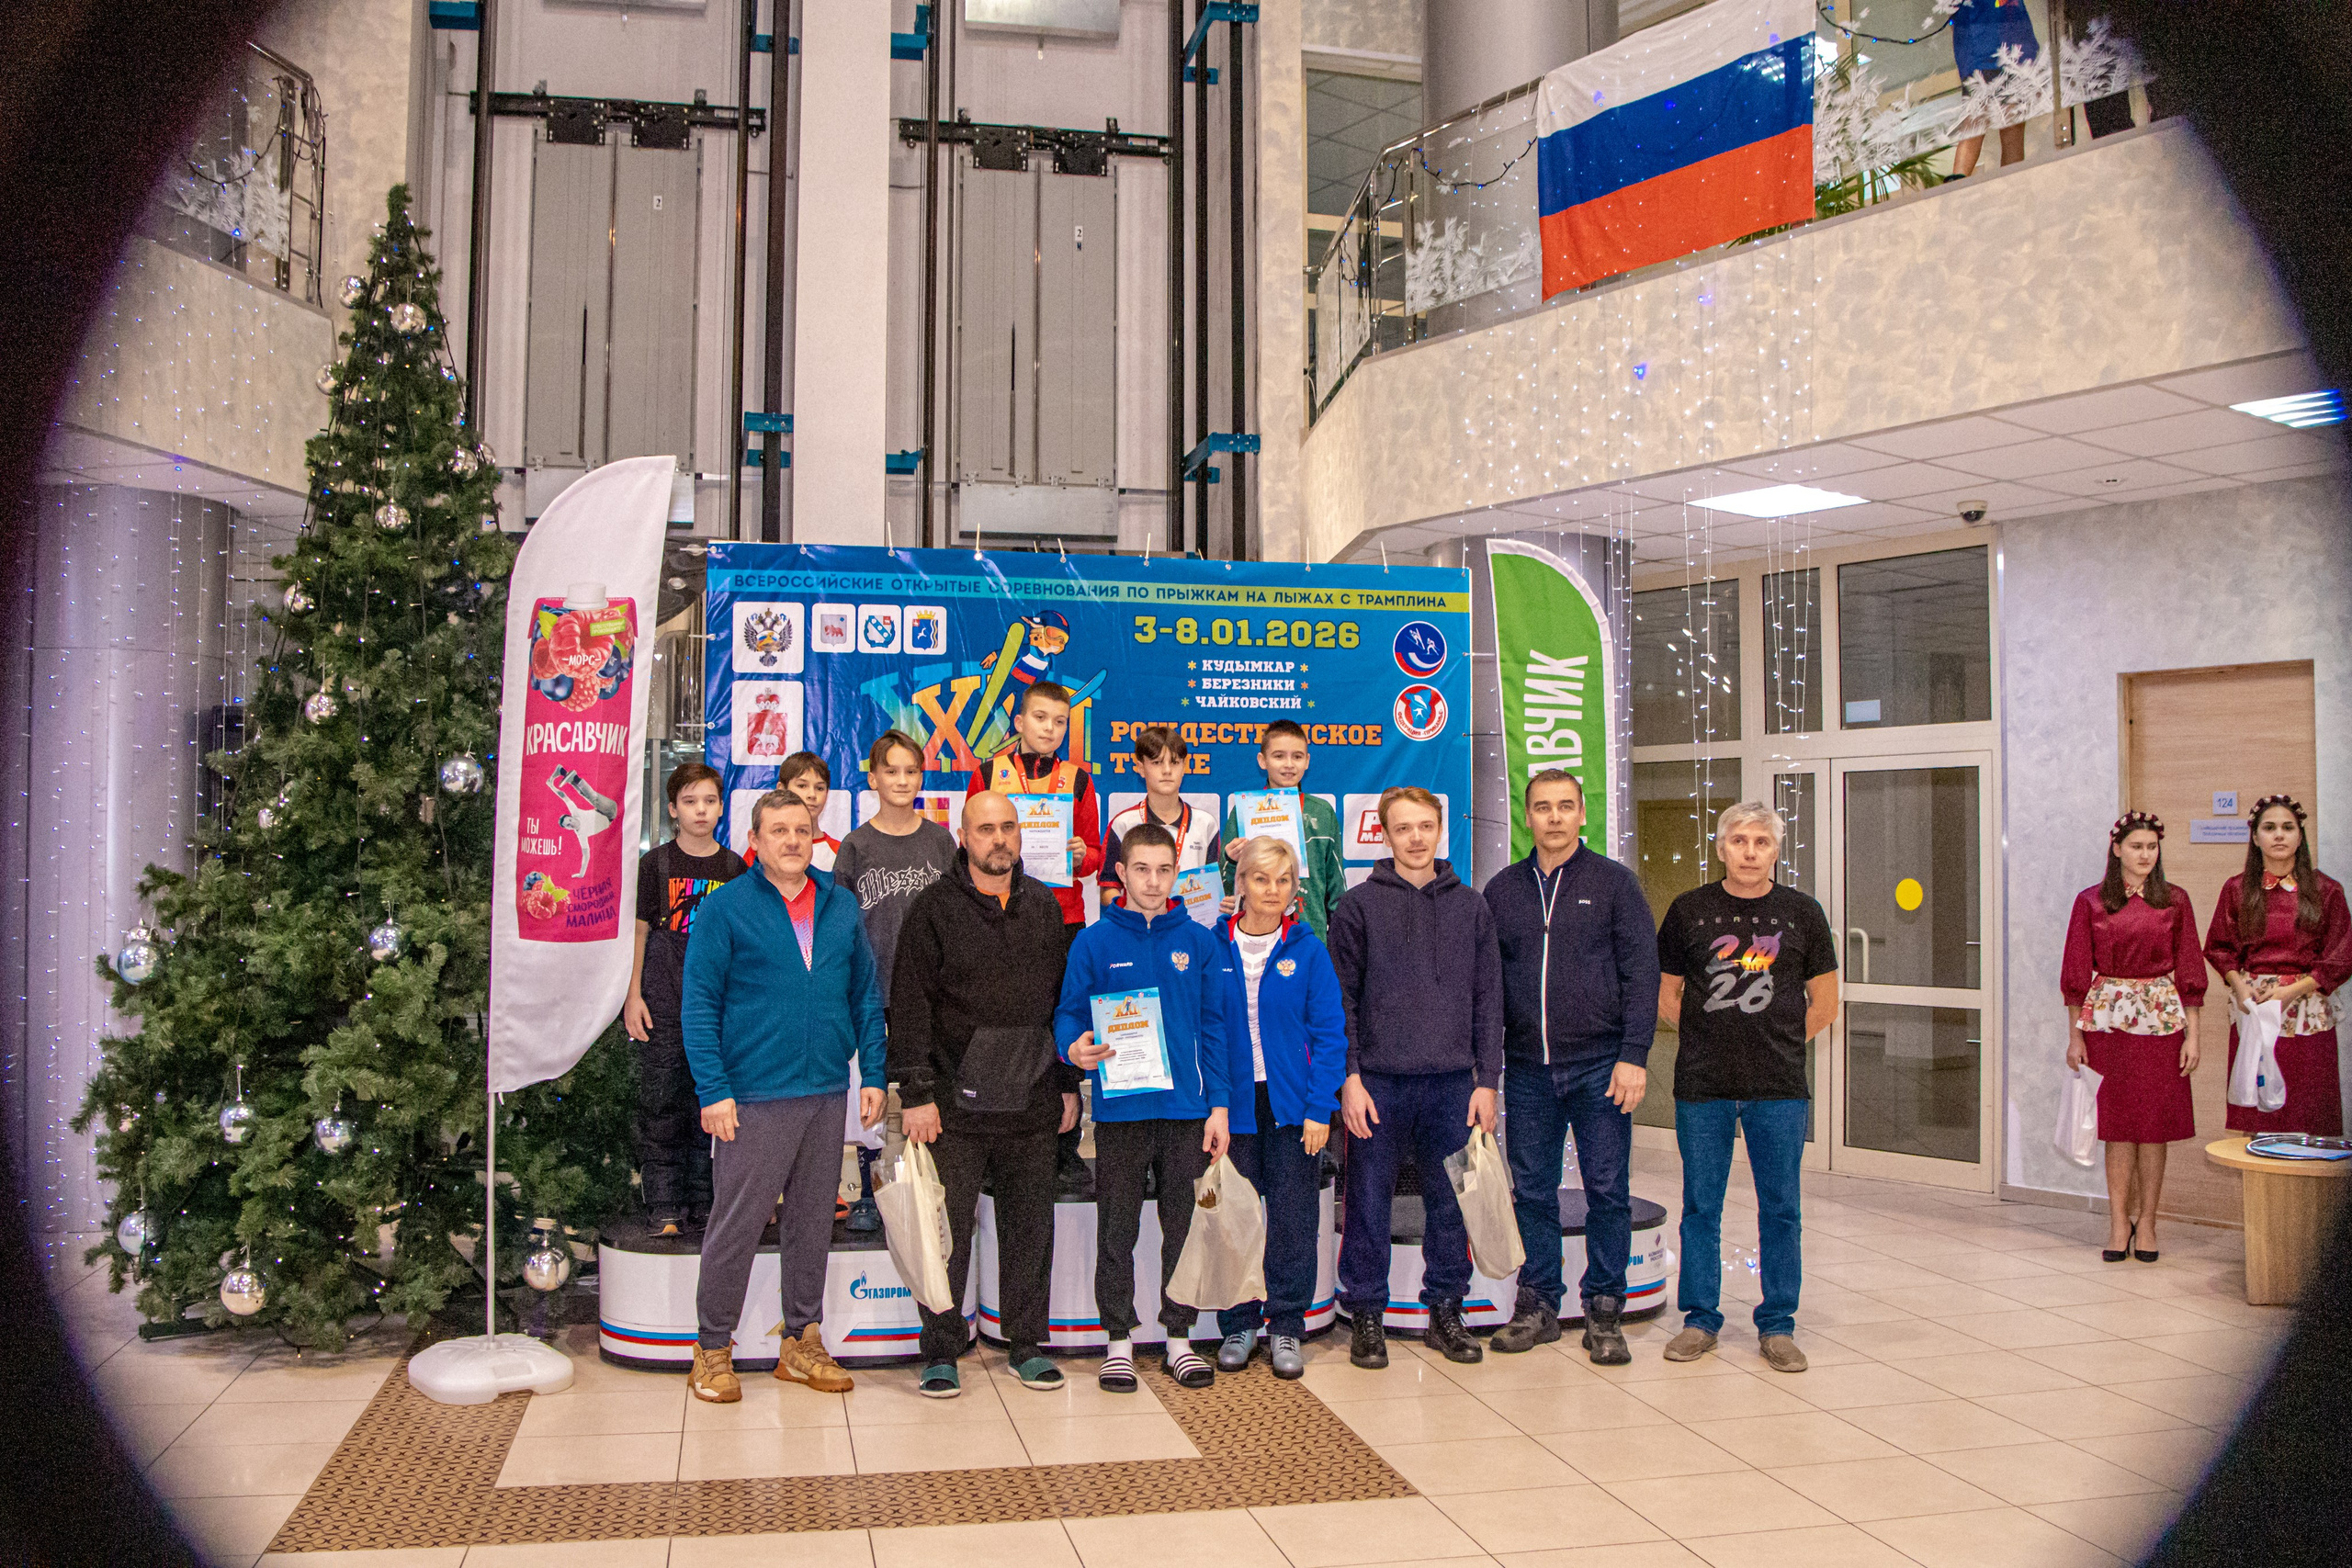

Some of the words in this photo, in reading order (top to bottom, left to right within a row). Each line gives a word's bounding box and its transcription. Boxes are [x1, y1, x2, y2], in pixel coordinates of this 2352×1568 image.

[1077, 229, 1082, 238] 2
[735, 573, 884, 591] ВСЕРОССИЙСКИЕ
[890, 577, 981, 593] ОТКРЫТЫЕ
[988, 581, 1120, 598] СОРЕВНОВАНИЯ
[1126, 586, 1149, 599] ПО
[1156, 587, 1239, 603] ПРЫЖКАМ
[1246, 591, 1267, 604] НА
[1272, 592, 1334, 605] ЛЫЖАХ
[1340, 593, 1351, 605] С
[1357, 593, 1447, 608] ТРАМПЛИНА
[1133, 615, 1361, 649] 3-8.01.2026
[567, 653, 597, 667] МОРС
[1201, 659, 1295, 674] КУДЫМКАР
[1201, 677, 1295, 692] БЕРЕЗНИКИ
[1194, 693, 1303, 710] ЧАЙКОВСКИЙ
[1523, 649, 1589, 788] АВЧИК
[526, 721, 629, 758] КРАСАВЧИК
[1110, 721, 1383, 747] РОДЕСТСКОЕ
[2217, 798, 2233, 808] 124
[526, 817, 540, 835] ТЫ
[1250, 814, 1290, 826] ДИПЛОМ
[520, 836, 562, 856] МОЖЕШЬ!
[566, 905, 616, 929] МАЛИНА
[1698, 916, 1795, 930] SEASON
[1109, 961, 1134, 970] FORWARD
[1107, 1020, 1150, 1034] ДИПЛОМ
[868, 1286, 912, 1300] ГАЗПРОМ
